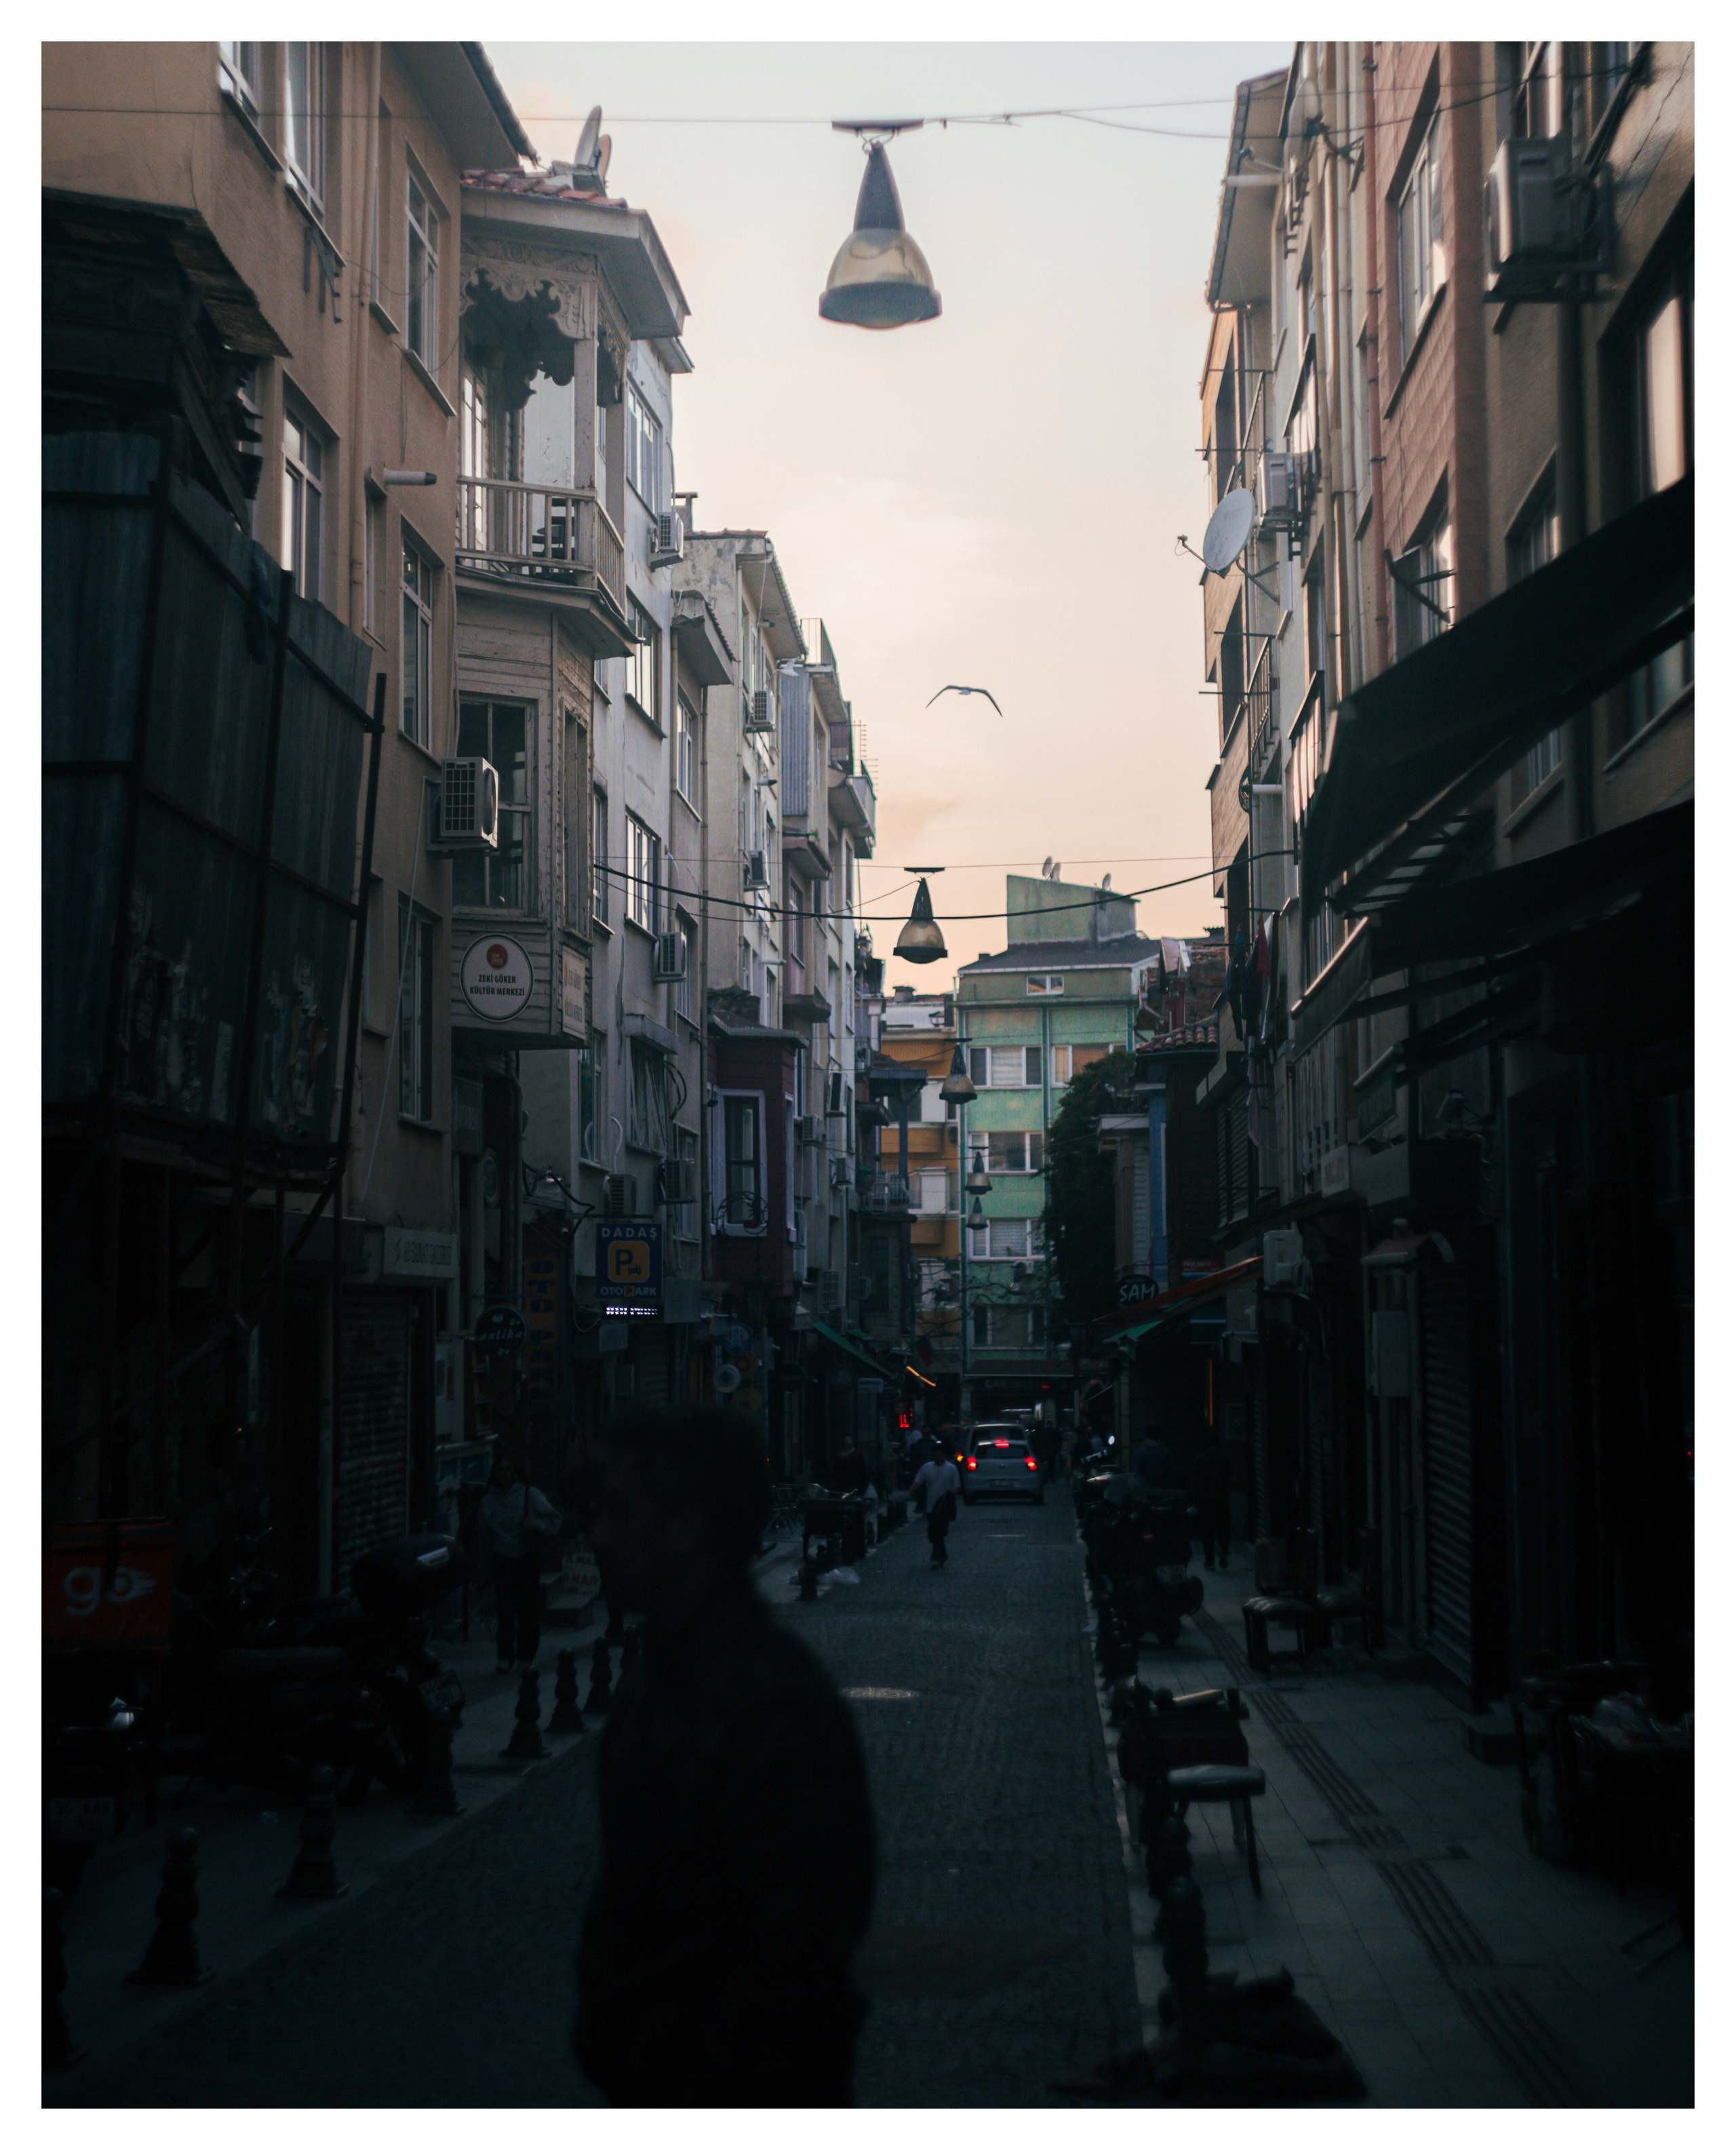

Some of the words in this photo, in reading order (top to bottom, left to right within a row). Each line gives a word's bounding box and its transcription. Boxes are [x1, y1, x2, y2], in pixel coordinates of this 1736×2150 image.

[478, 974, 493, 983] ZEKİ
[494, 975, 516, 983] GÖKER
[469, 986, 495, 995] KÜLTÜR
[496, 987, 525, 996] MERKEZİ
[601, 1227, 658, 1241] DADAŞ
[615, 1249, 633, 1276] P
[600, 1286, 657, 1297] OTOPARK
[1119, 1283, 1156, 1302] SAM
[479, 1327, 524, 1341] antika
